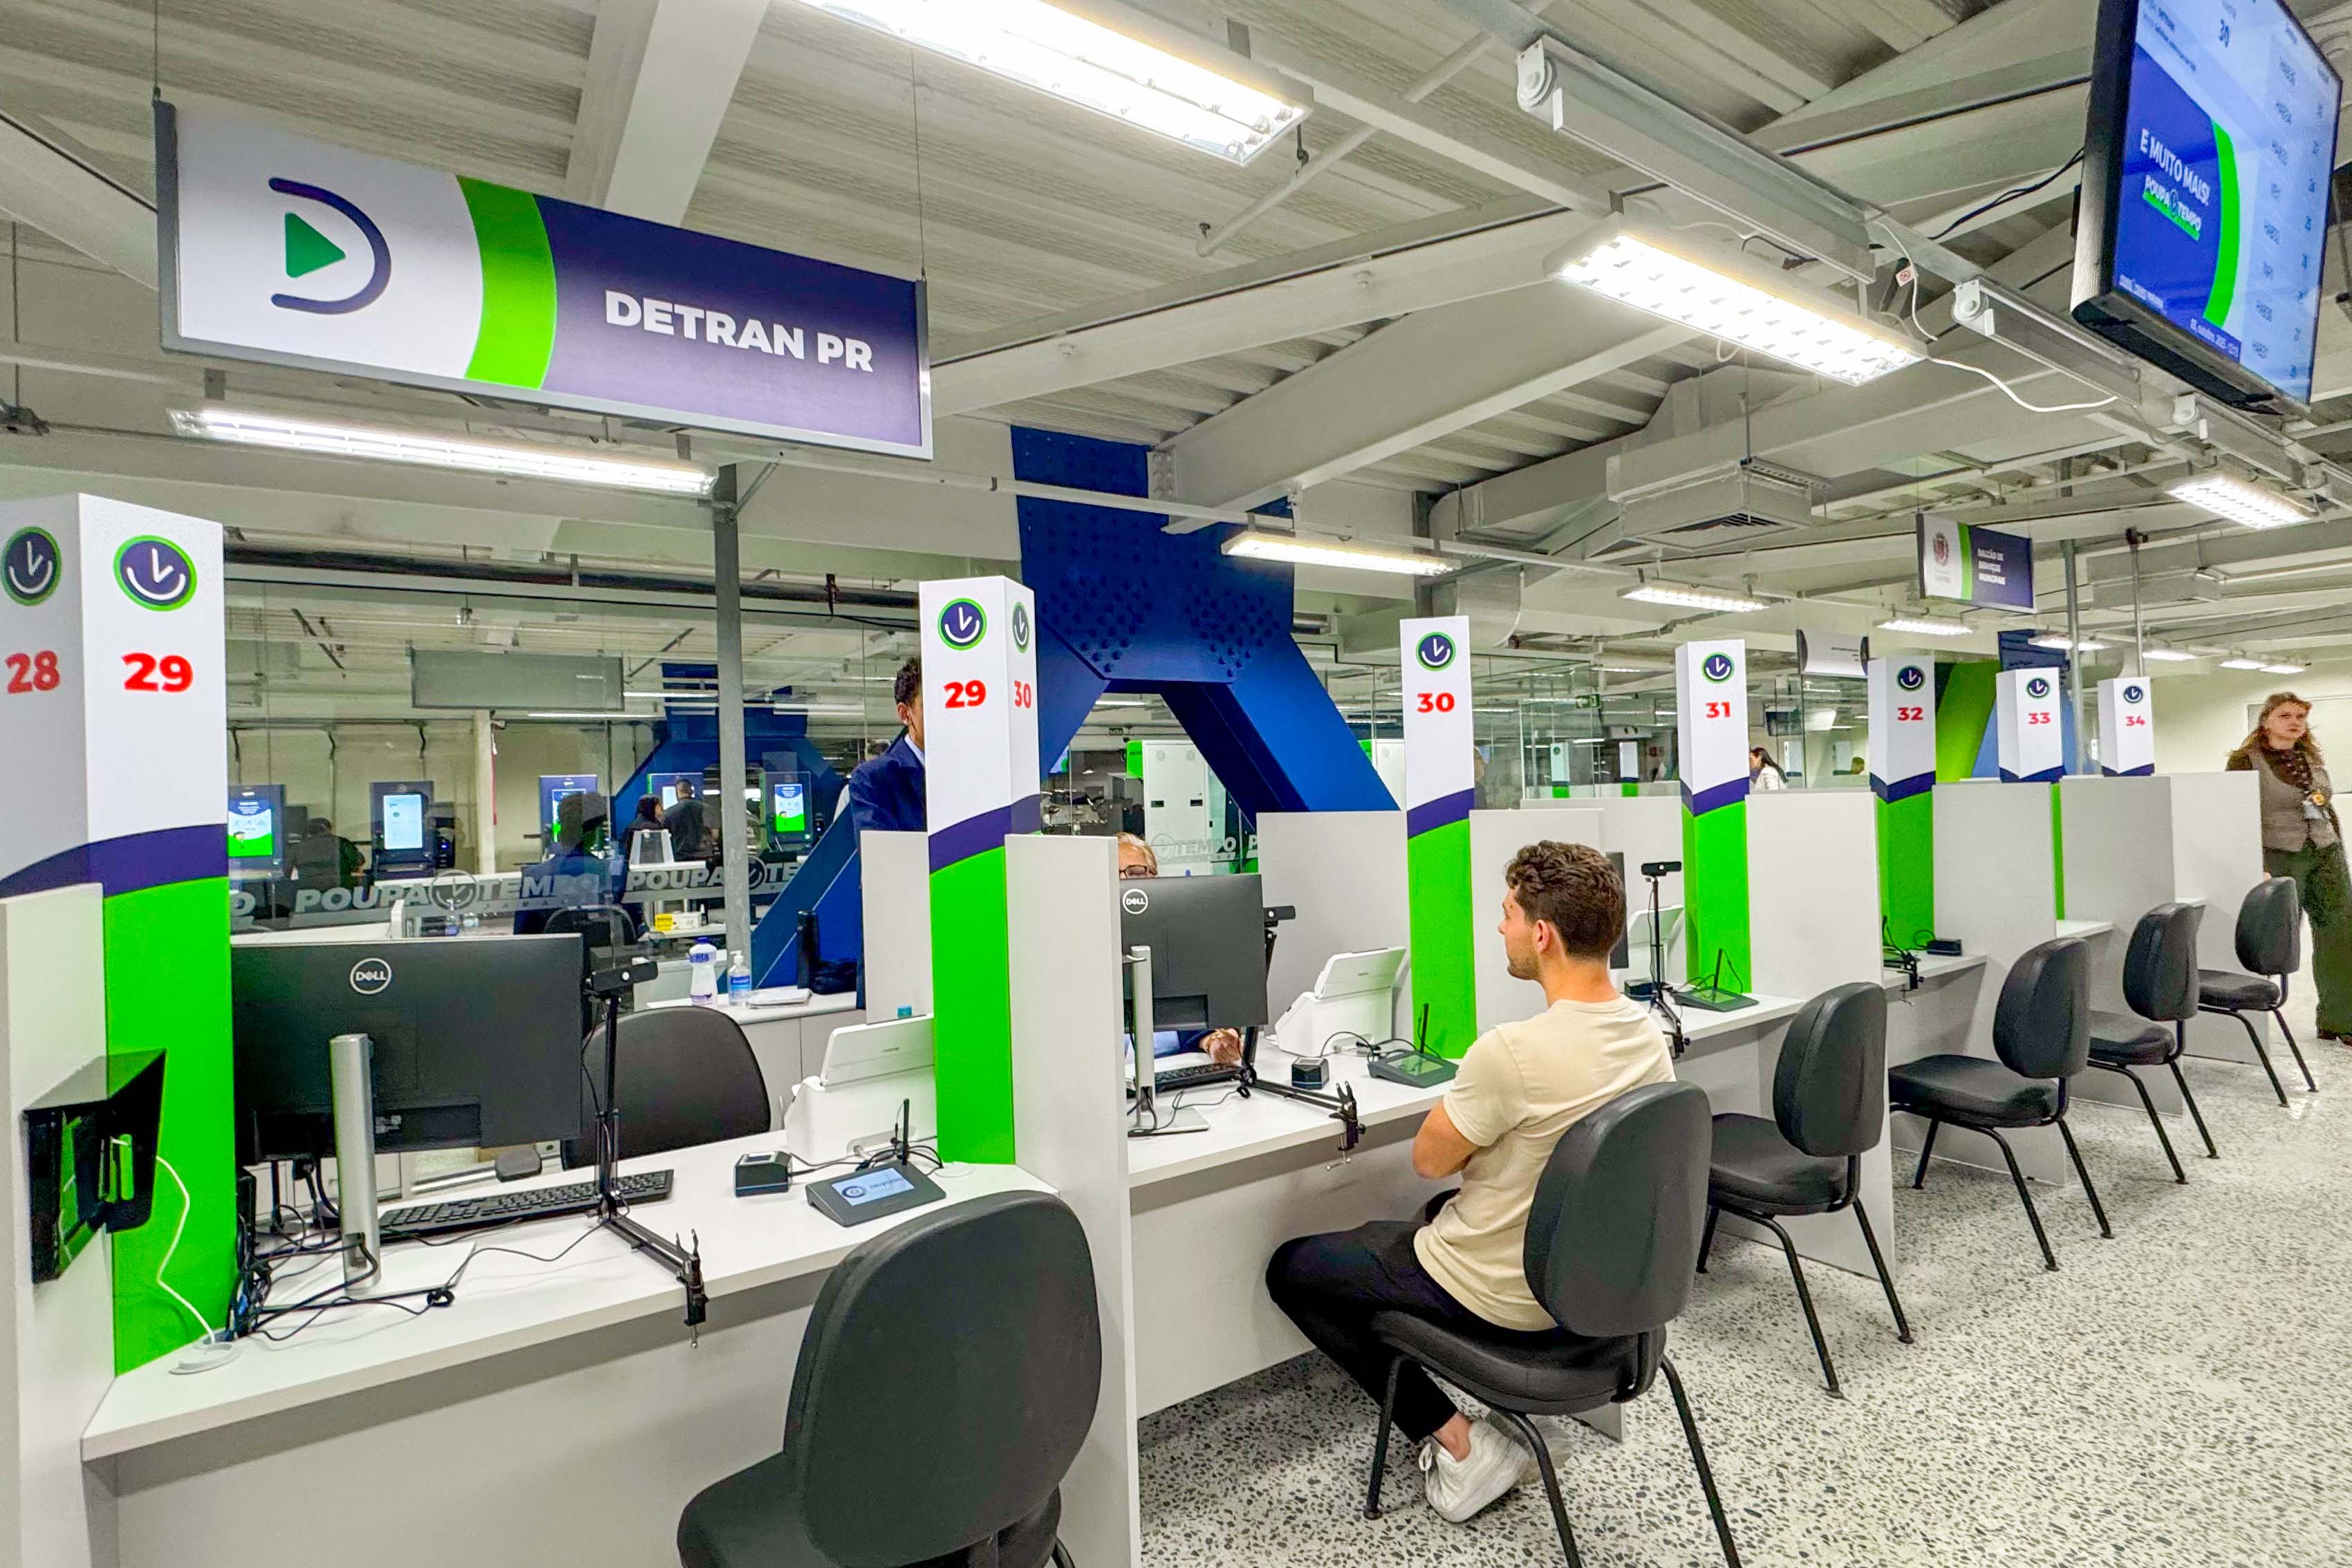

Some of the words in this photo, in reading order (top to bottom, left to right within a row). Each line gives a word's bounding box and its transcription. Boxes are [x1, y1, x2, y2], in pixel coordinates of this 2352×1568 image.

[2149, 136, 2183, 182] MUITO
[2183, 166, 2210, 206] MAIS!
[2145, 174, 2170, 206] POUPA
[2178, 201, 2202, 232] TEMPO
[605, 290, 805, 360] DETRAN
[817, 333, 874, 373] PR
[6, 650, 61, 694] 28
[121, 652, 194, 693] 29
[944, 679, 987, 709] 29
[1014, 680, 1032, 709] 30
[1417, 692, 1455, 713] 30
[1706, 701, 1731, 719] 31
[1897, 706, 1924, 722] 32
[2028, 711, 2052, 725] 33
[2125, 716, 2146, 727] 34
[296, 884, 430, 914] POUPA
[1126, 897, 1146, 906] DELL
[355, 971, 387, 981] DELL
